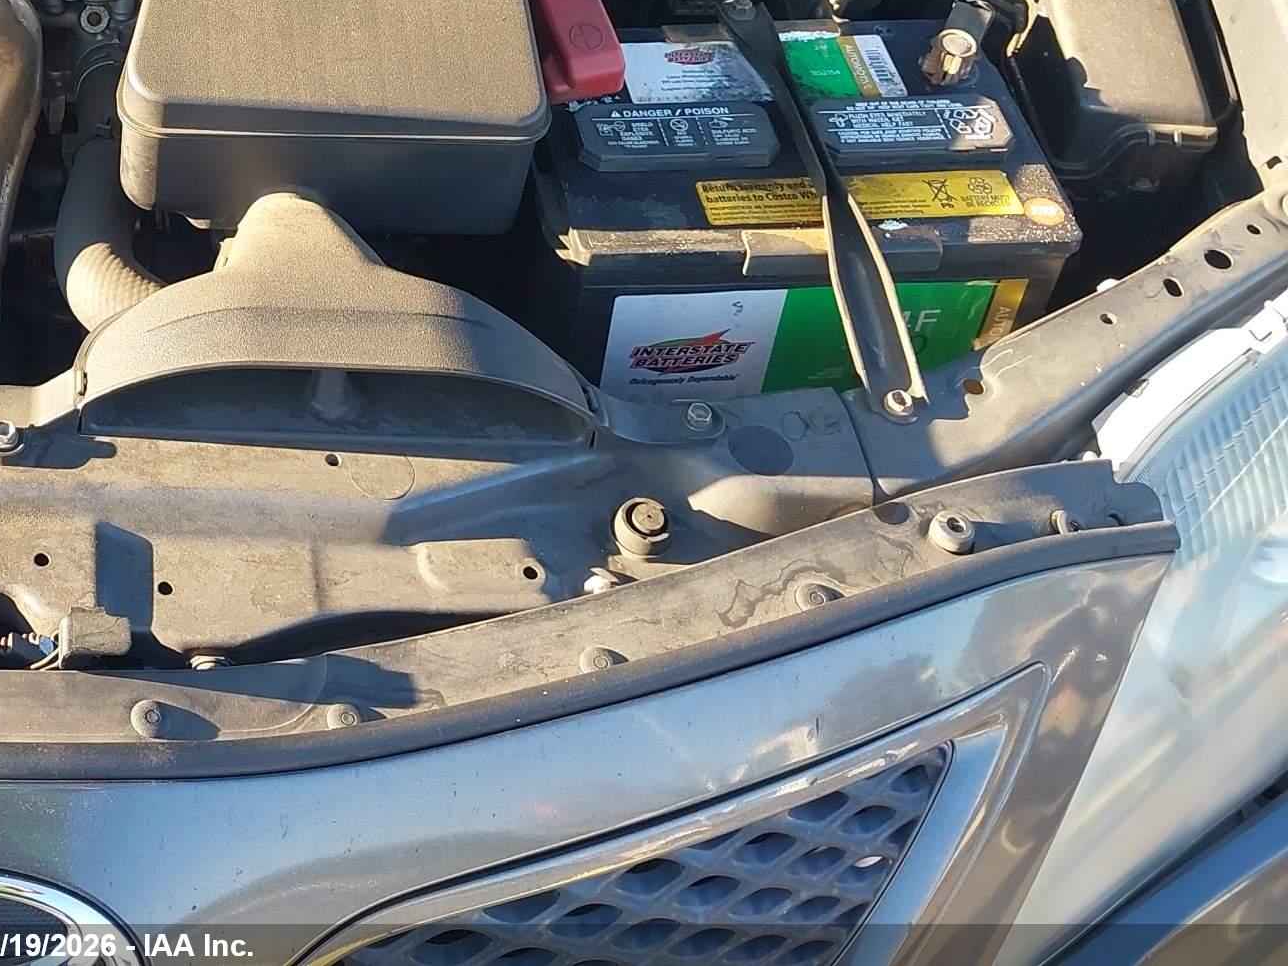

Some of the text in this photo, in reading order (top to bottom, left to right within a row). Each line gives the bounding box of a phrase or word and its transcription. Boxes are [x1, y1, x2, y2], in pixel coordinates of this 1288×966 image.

[623, 108, 672, 118] DANGER
[685, 106, 729, 116] POISON
[706, 193, 751, 204] batteries
[754, 193, 764, 202] to
[765, 191, 798, 202] Costco
[634, 344, 748, 357] INTERSTATE
[634, 354, 737, 367] BATTERIES
